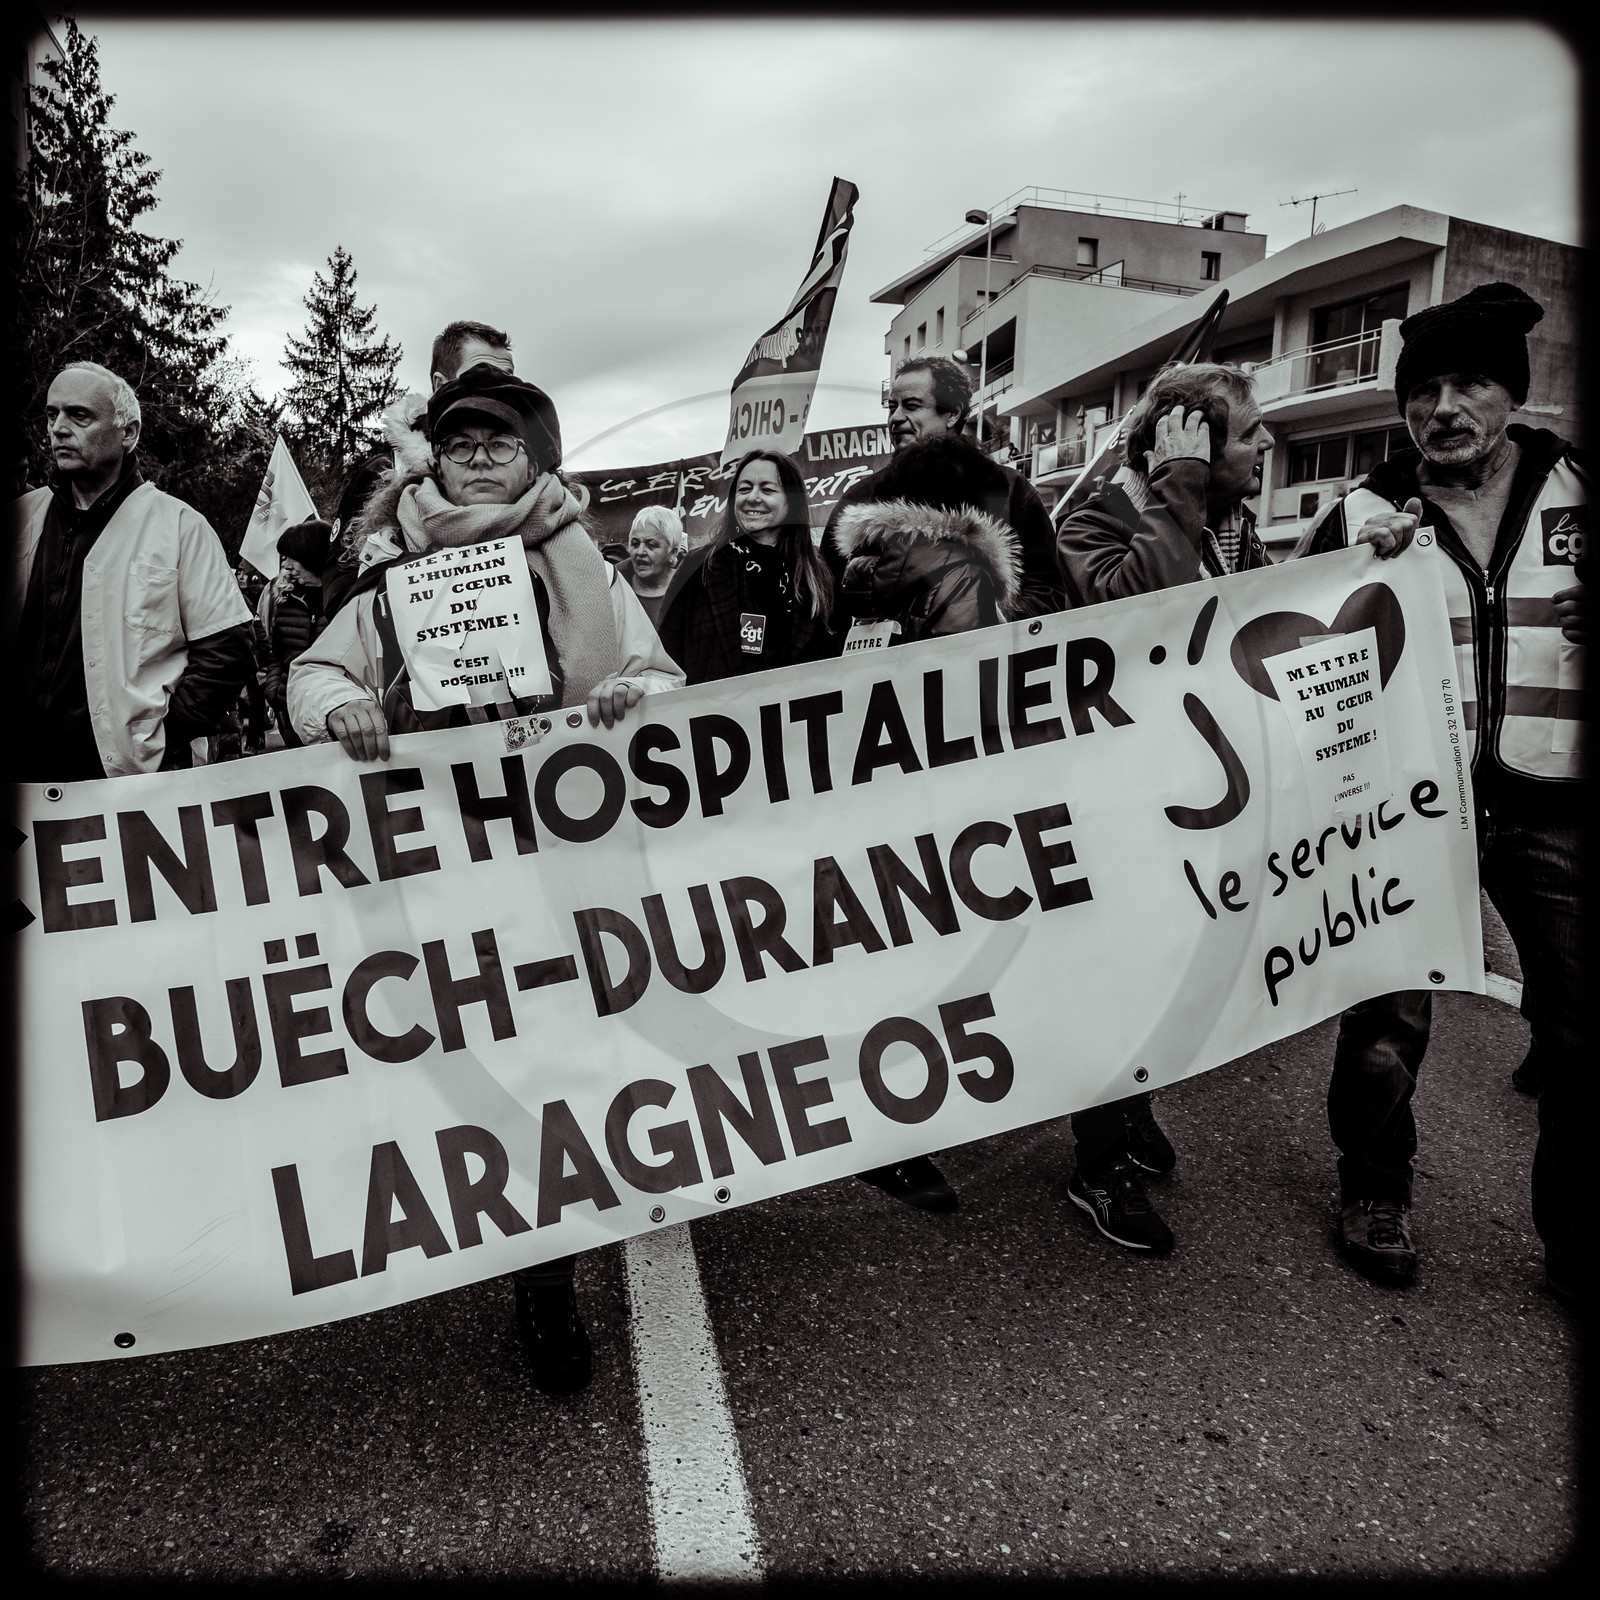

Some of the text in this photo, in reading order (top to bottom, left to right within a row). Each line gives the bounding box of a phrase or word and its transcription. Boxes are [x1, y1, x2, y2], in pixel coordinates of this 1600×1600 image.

[806, 427, 895, 461] LARAGN
[404, 541, 506, 570] METTRE
[407, 557, 506, 585] L'HUMAIN
[409, 574, 512, 604] AU CŒUR
[450, 599, 478, 614] DU
[846, 637, 882, 651] METTRE
[1286, 648, 1369, 682] METTRE
[1297, 669, 1370, 701] L'HUMAIN
[1304, 690, 1374, 722] AU CŒUR
[1336, 718, 1354, 734] DU
[1441, 678, 1469, 830] LM Communication 02 32 18 07 70
[3, 637, 1135, 934] ENTRE HOSPITALIER
[1342, 773, 1356, 784] PAS
[1182, 778, 1449, 920] le service
[1263, 866, 1416, 1007] public
[81, 802, 1094, 1123] BUËCH-DURANCE
[271, 991, 1015, 1296] LARAGNE 05
